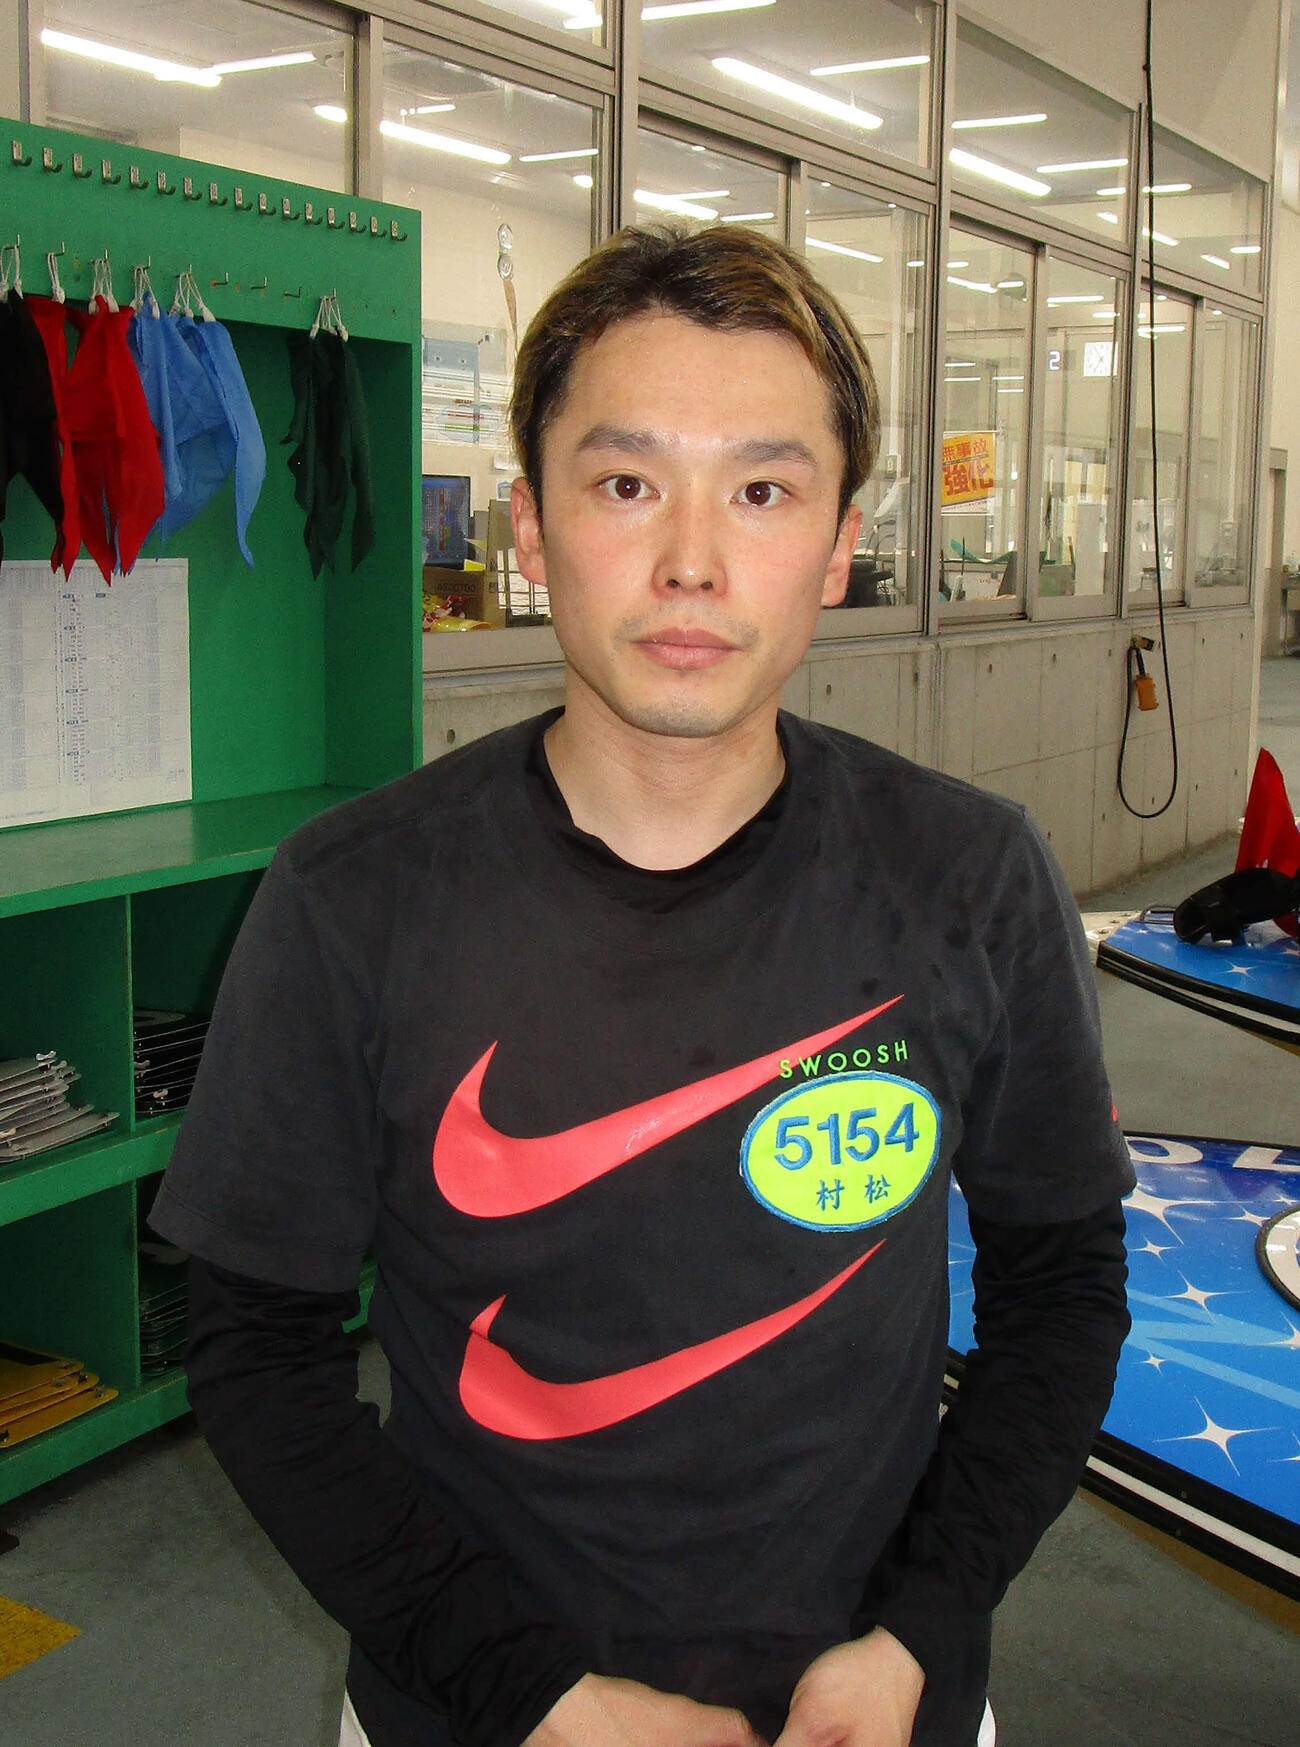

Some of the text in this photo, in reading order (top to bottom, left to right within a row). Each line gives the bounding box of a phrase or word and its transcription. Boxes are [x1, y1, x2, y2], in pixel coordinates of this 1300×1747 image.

[942, 459, 993, 496] 強化
[779, 1039, 909, 1078] SWOOSH
[774, 1102, 920, 1171] 5154
[816, 1174, 891, 1211] 村松
